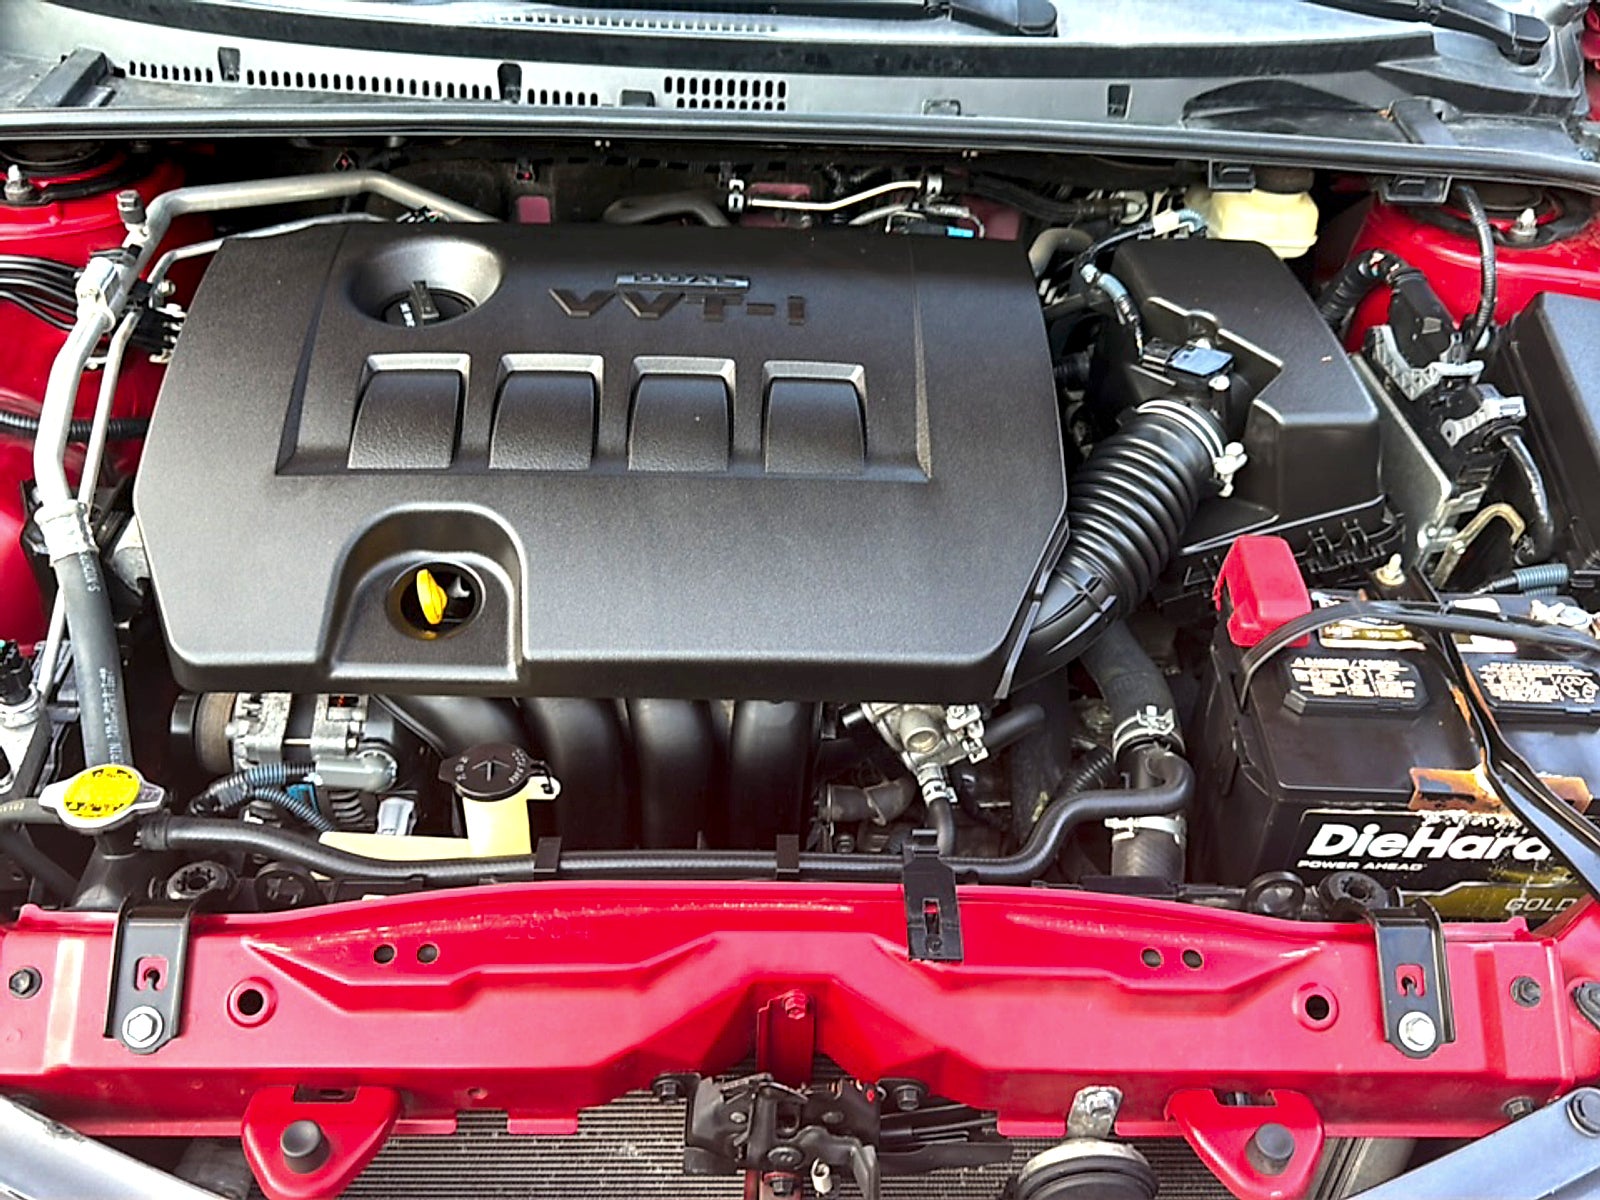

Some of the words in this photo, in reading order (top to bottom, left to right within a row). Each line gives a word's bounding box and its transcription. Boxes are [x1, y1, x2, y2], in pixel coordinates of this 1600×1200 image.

[1297, 860, 1360, 870] POWER
[1361, 861, 1425, 872] AHEAD
[1504, 898, 1578, 911] GOLD
